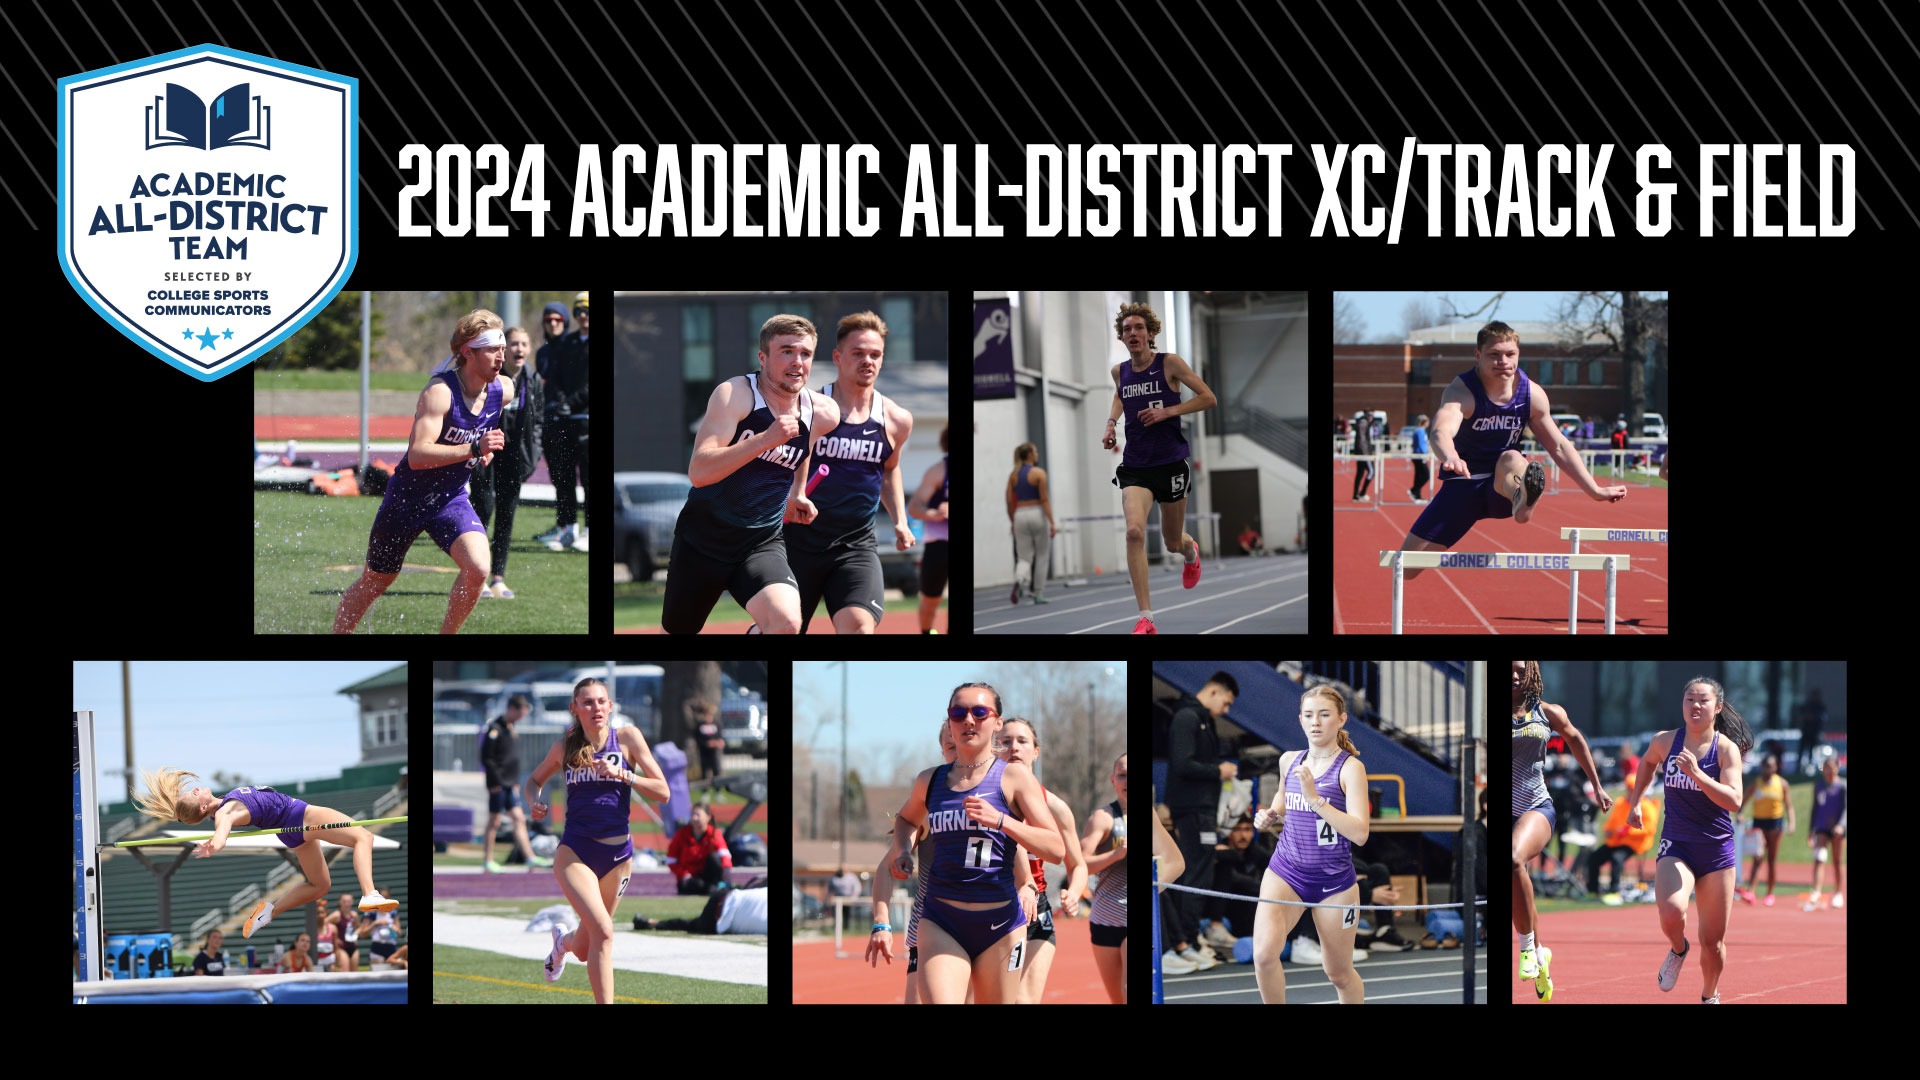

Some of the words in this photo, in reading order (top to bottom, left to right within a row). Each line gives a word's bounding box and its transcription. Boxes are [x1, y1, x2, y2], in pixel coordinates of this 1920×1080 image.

[1122, 381, 1163, 399] CORNELL
[444, 426, 492, 444] CORNE
[737, 429, 804, 470] CNELL
[816, 435, 884, 464] CORNELL
[1607, 530, 1655, 543] CORNELL
[1659, 531, 1669, 543] C
[1440, 554, 1502, 568] CORNELL
[1507, 555, 1570, 569] COLLEGE
[565, 766, 622, 785] CORN
[1664, 773, 1703, 792] CORN
[75, 813, 82, 821] 6
[928, 809, 999, 834] CORN
[1320, 822, 1335, 843] 4
